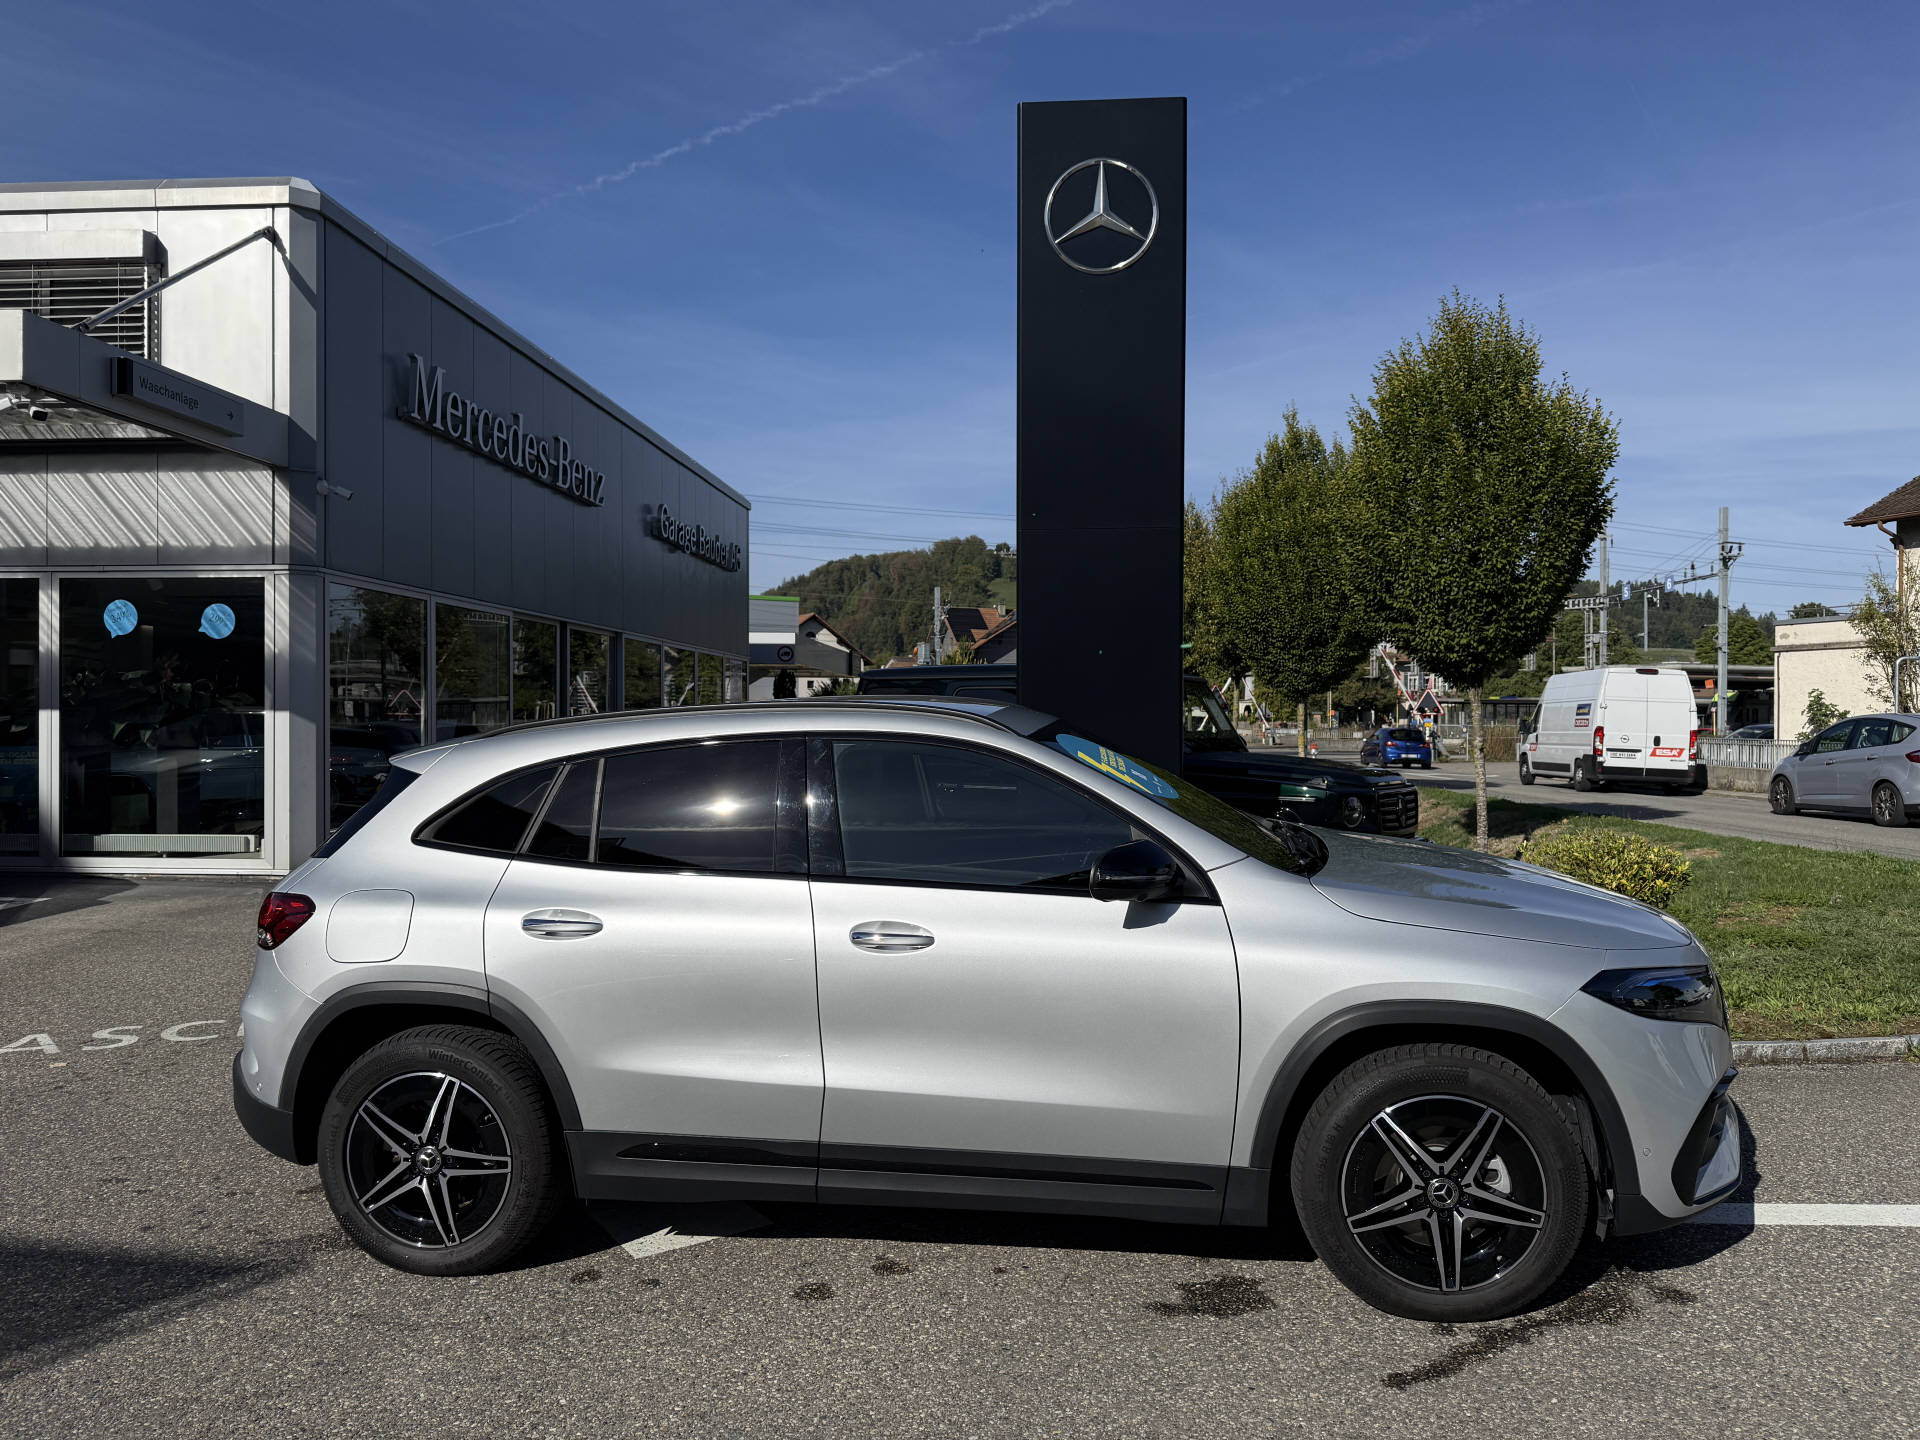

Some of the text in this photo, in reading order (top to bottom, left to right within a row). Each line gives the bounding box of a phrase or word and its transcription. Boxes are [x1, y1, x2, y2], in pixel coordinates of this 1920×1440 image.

[139, 376, 199, 410] Waschanlage
[409, 353, 606, 506] Mercedes-Benz
[660, 503, 743, 571] Garage Bauder AG
[1656, 748, 1679, 757] ESA
[0, 1020, 244, 1055] ASC
[427, 1049, 503, 1092] WinterContact
